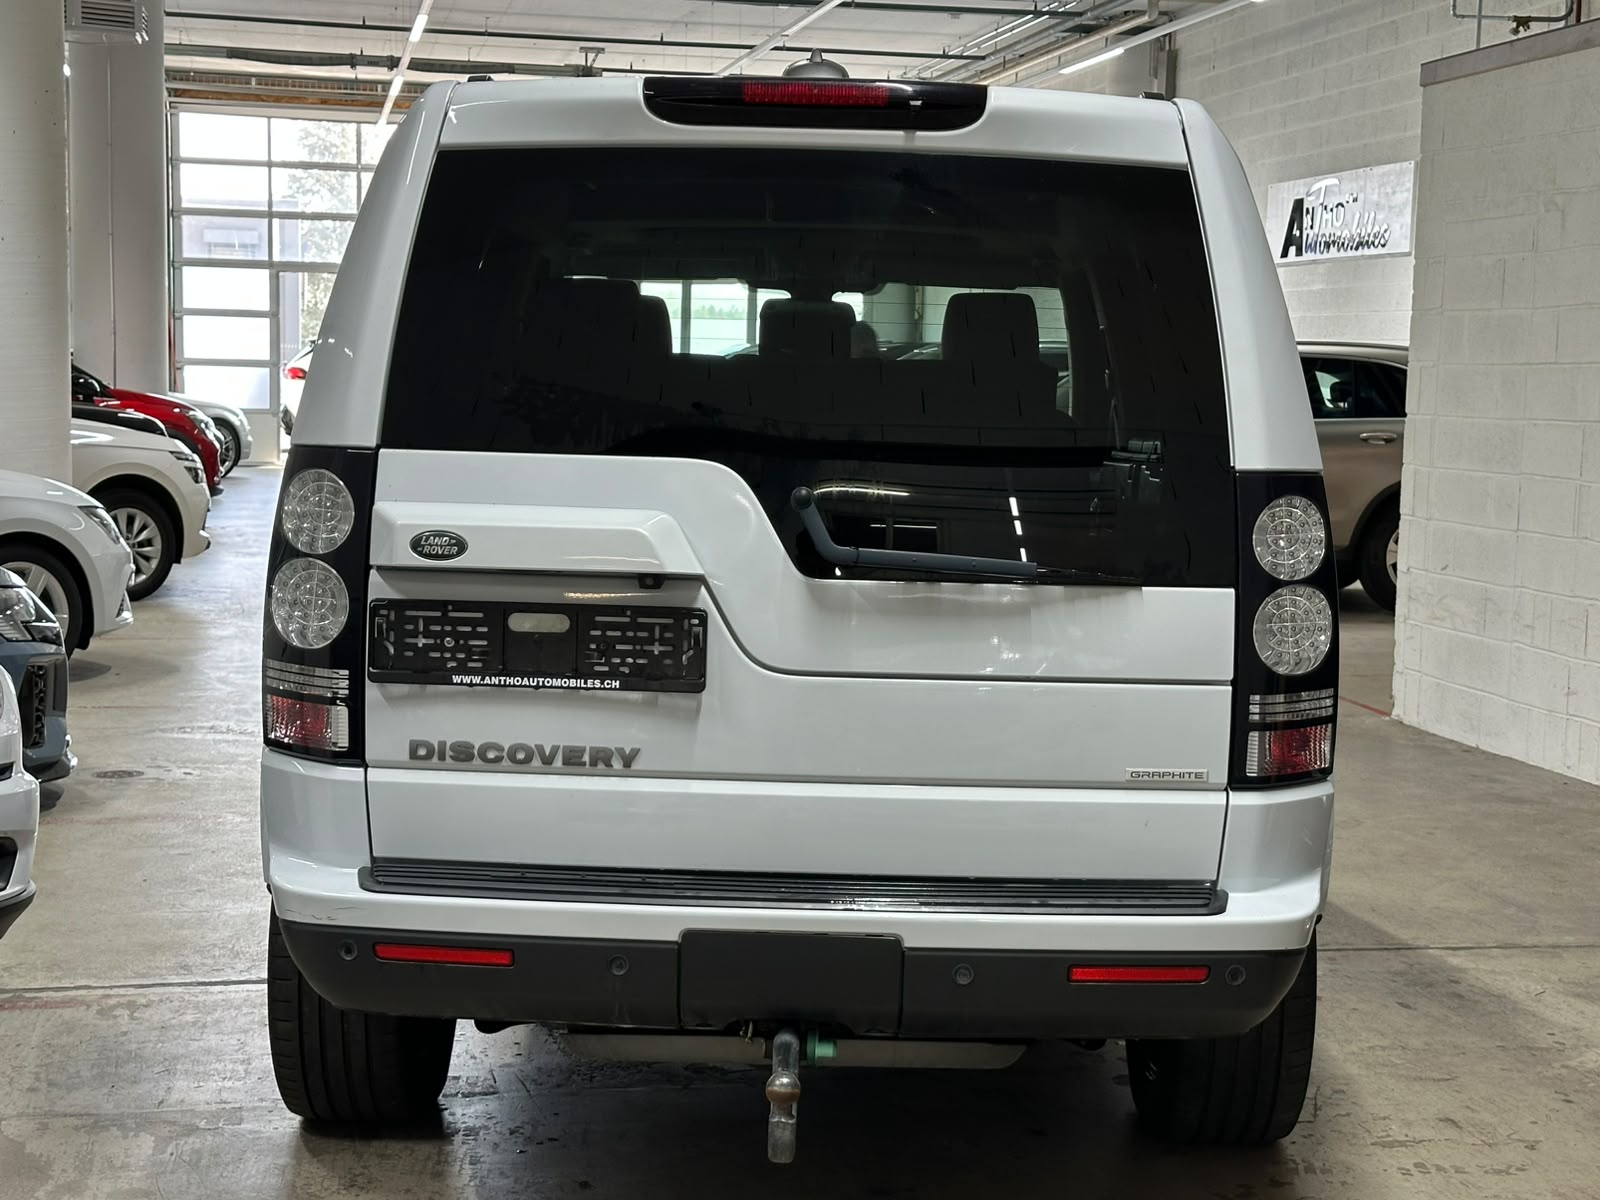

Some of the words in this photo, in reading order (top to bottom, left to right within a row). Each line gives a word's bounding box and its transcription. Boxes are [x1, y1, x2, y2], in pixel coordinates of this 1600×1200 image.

[421, 536, 450, 546] LAND
[422, 545, 458, 555] ROVER
[452, 675, 620, 689] WWW.ANTHOAUTOMOBILES.CH
[409, 739, 641, 769] DISCOVERY
[1130, 771, 1205, 779] GRAPHITE
